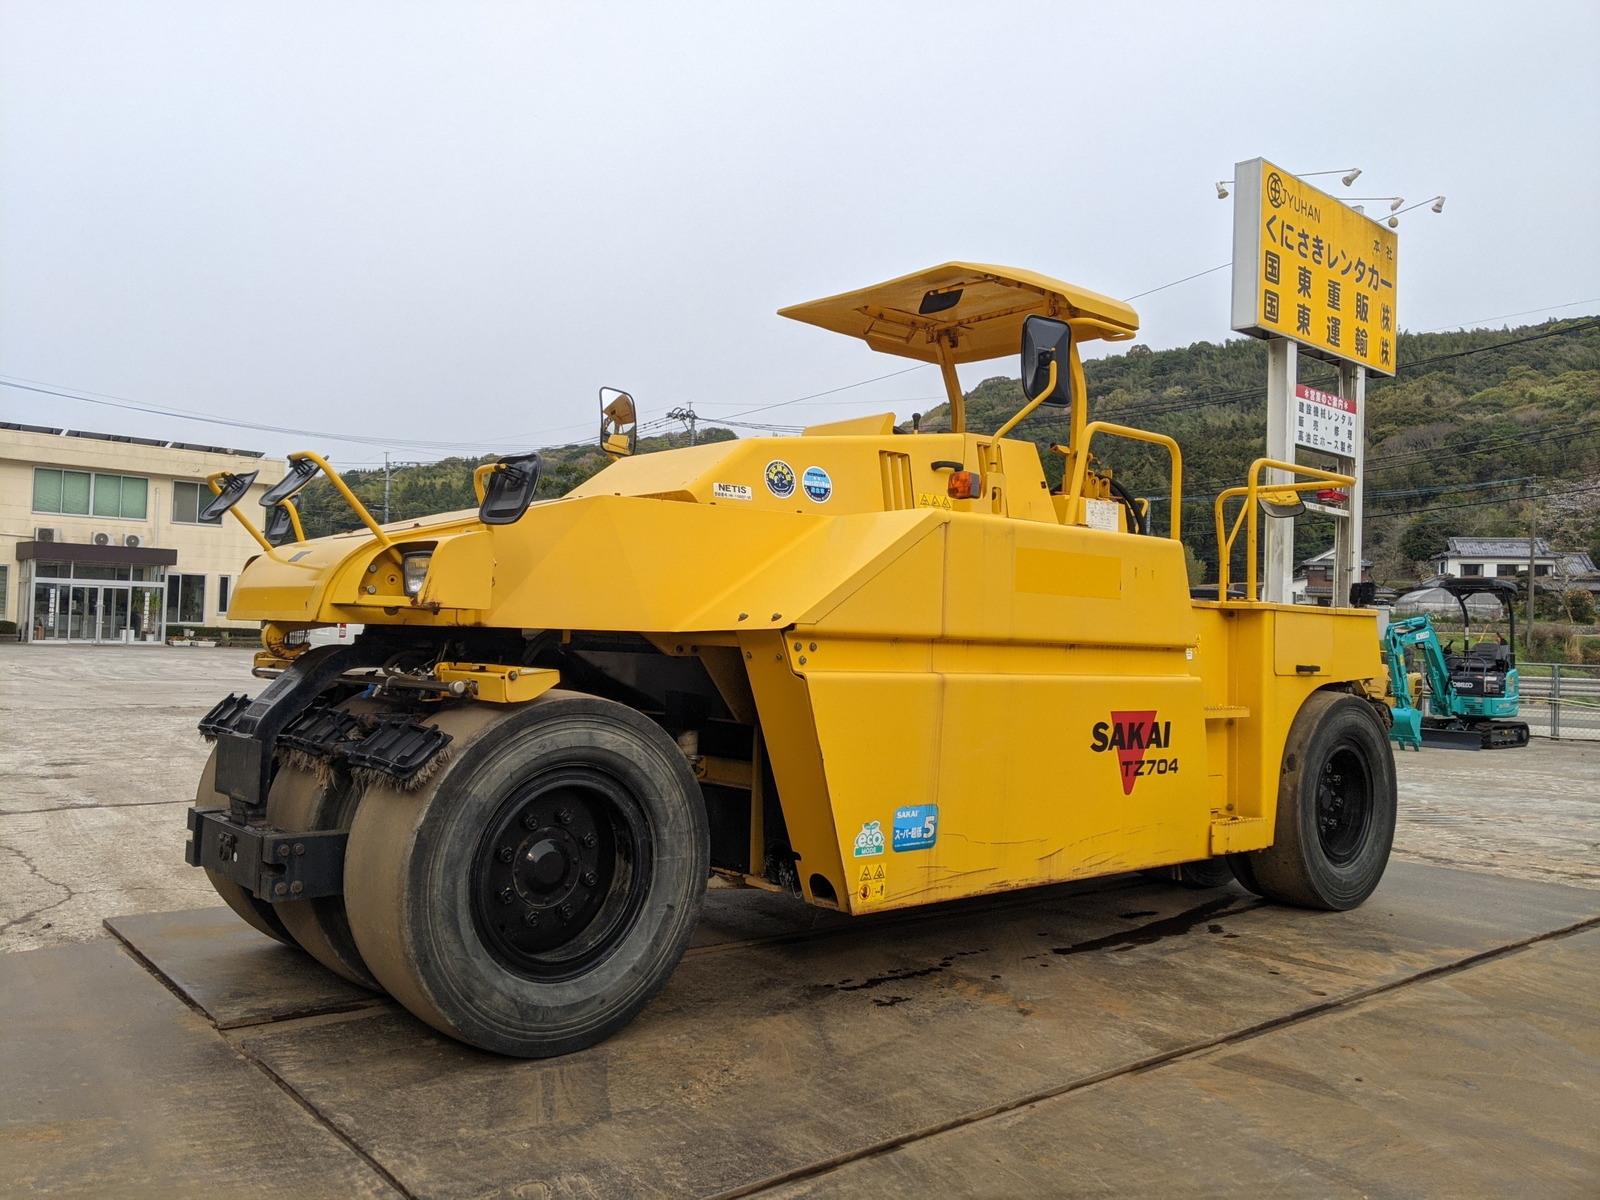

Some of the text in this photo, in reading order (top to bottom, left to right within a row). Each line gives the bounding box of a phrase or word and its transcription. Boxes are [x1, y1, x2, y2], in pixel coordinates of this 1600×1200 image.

[1280, 188, 1321, 223] JYUHAN
[1266, 214, 1393, 292] くにさきレンタカー
[1372, 239, 1393, 261] 本社
[1299, 401, 1353, 427] 建設機械レンタル
[718, 483, 747, 494] NETIS
[1450, 680, 1474, 689] OBELCO
[1090, 721, 1171, 753] SAKAI
[1122, 758, 1179, 778] TZ704
[896, 810, 918, 819] SAKAI
[857, 832, 883, 848] eco
[861, 847, 877, 855] MODE
